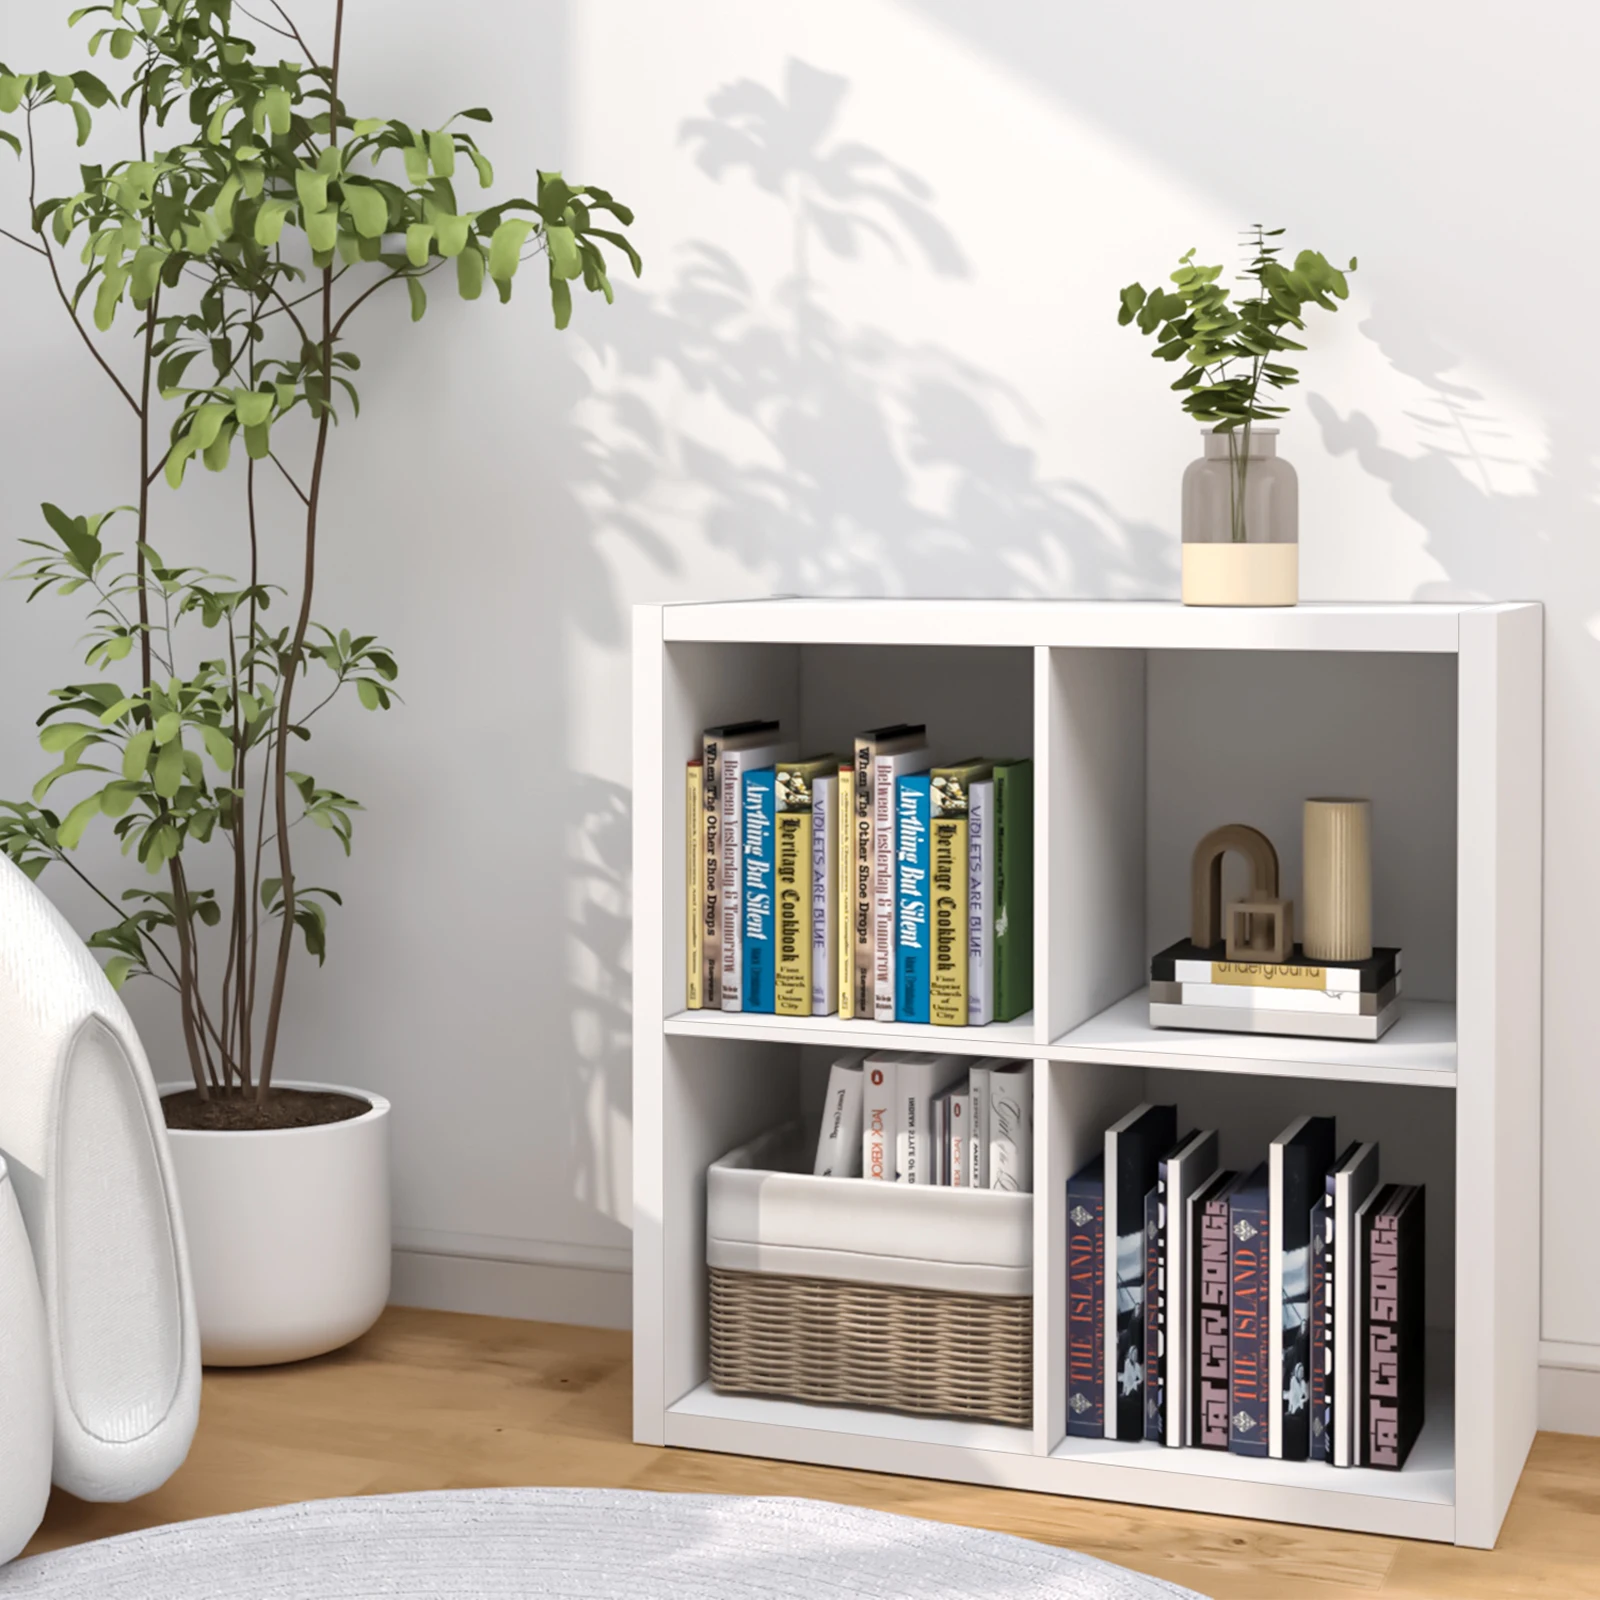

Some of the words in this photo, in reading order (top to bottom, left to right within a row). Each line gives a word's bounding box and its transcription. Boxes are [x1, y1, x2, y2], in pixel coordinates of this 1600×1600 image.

[706, 743, 718, 782] When
[723, 760, 738, 818] Between
[859, 747, 870, 787] When
[706, 786, 718, 812] The
[742, 780, 771, 857] Anything
[859, 791, 870, 817] The
[876, 764, 892, 822] Between
[706, 816, 718, 855] Other
[778, 817, 801, 884] Heritage
[813, 800, 825, 866] VIOLETS
[859, 821, 870, 862] Other
[897, 785, 925, 864] Anything
[970, 805, 982, 872] VIOLETS
[706, 859, 718, 891] Shoe
[722, 821, 739, 887] Yesterday
[746, 859, 770, 889] But
[875, 826, 893, 895] Yesterday
[934, 824, 957, 892] Heritage
[813, 870, 825, 905] ARE
[859, 865, 870, 899] Shoe
[900, 865, 925, 897] But
[970, 876, 982, 911] ARE
[705, 895, 718, 936] Drops
[723, 903, 739, 974] Tomorrow
[746, 891, 771, 941] Silent
[778, 888, 800, 962] Cookbook
[813, 908, 825, 949] BLUE
[857, 902, 870, 944] Drops
[900, 898, 925, 949] Silent
[935, 896, 957, 972] Cookbook
[970, 916, 982, 958] BLUE
[876, 911, 892, 983] Tomorrow
[1070, 1234, 1093, 1324] ISLAND
[1233, 1249, 1258, 1341] ISLAND
[1070, 1333, 1094, 1385] THE
[1233, 1350, 1258, 1404] THE
[1201, 1380, 1228, 1447] FAT
[1369, 1398, 1398, 1467] FAT
